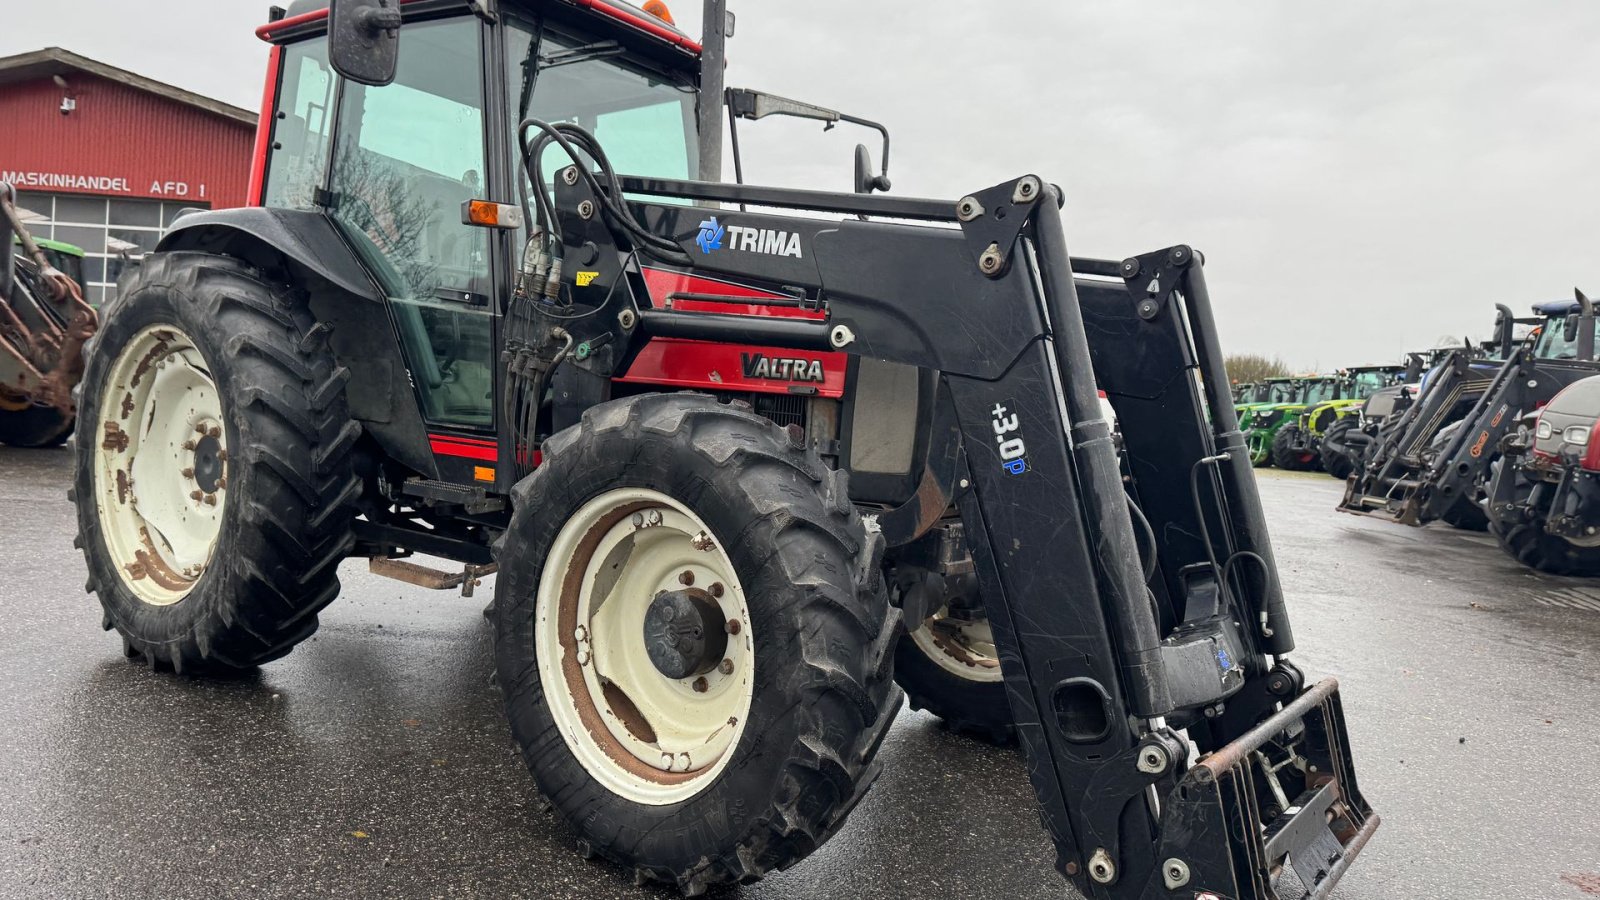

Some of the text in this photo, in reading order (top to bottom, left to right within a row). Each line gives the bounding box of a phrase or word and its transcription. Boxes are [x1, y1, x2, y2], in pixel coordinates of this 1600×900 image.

[2, 171, 205, 197] MASKINHANDEL AFD 1
[727, 225, 802, 259] TRIMA
[741, 352, 824, 383] VALTRA
